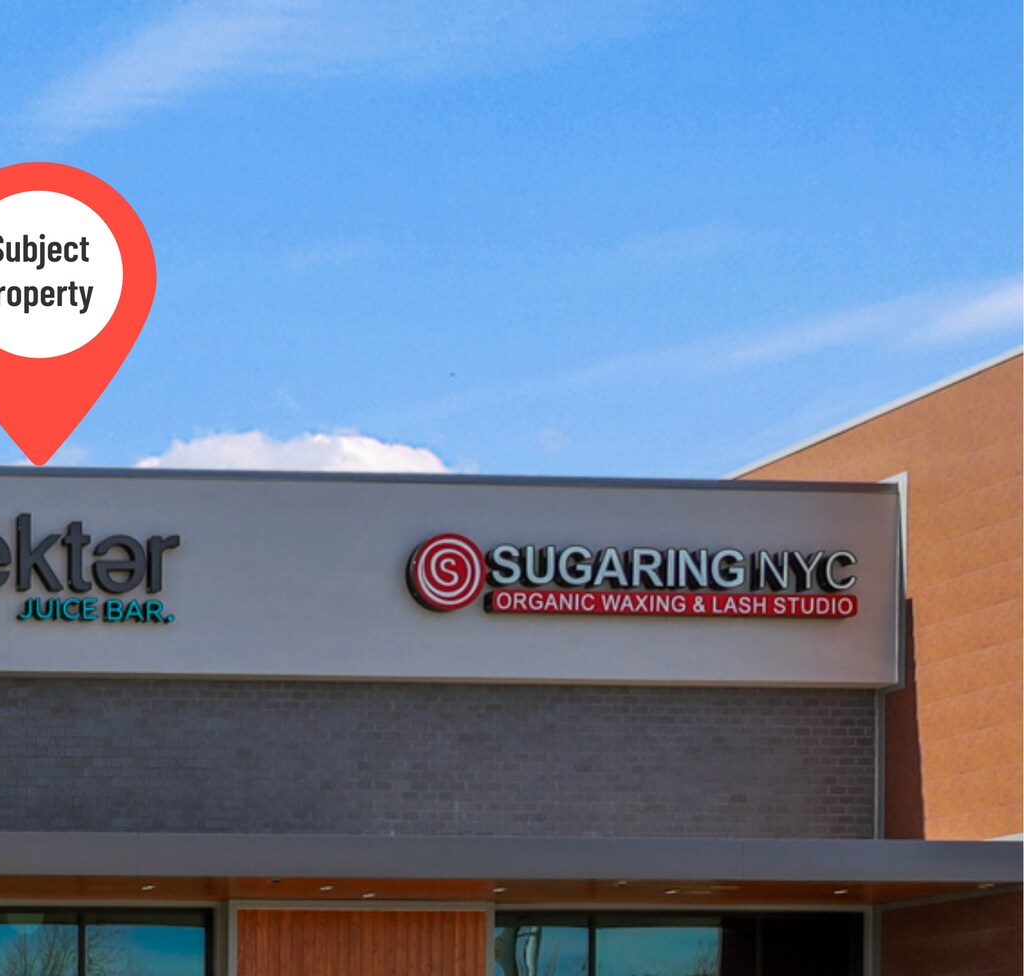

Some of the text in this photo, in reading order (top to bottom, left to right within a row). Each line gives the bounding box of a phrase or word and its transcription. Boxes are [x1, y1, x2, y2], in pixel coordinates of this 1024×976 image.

[489, 544, 857, 591] SUGARING NYC
[18, 597, 98, 620] JUICE
[496, 591, 854, 615] ORGANIC WAXING & LASH STUDIO
